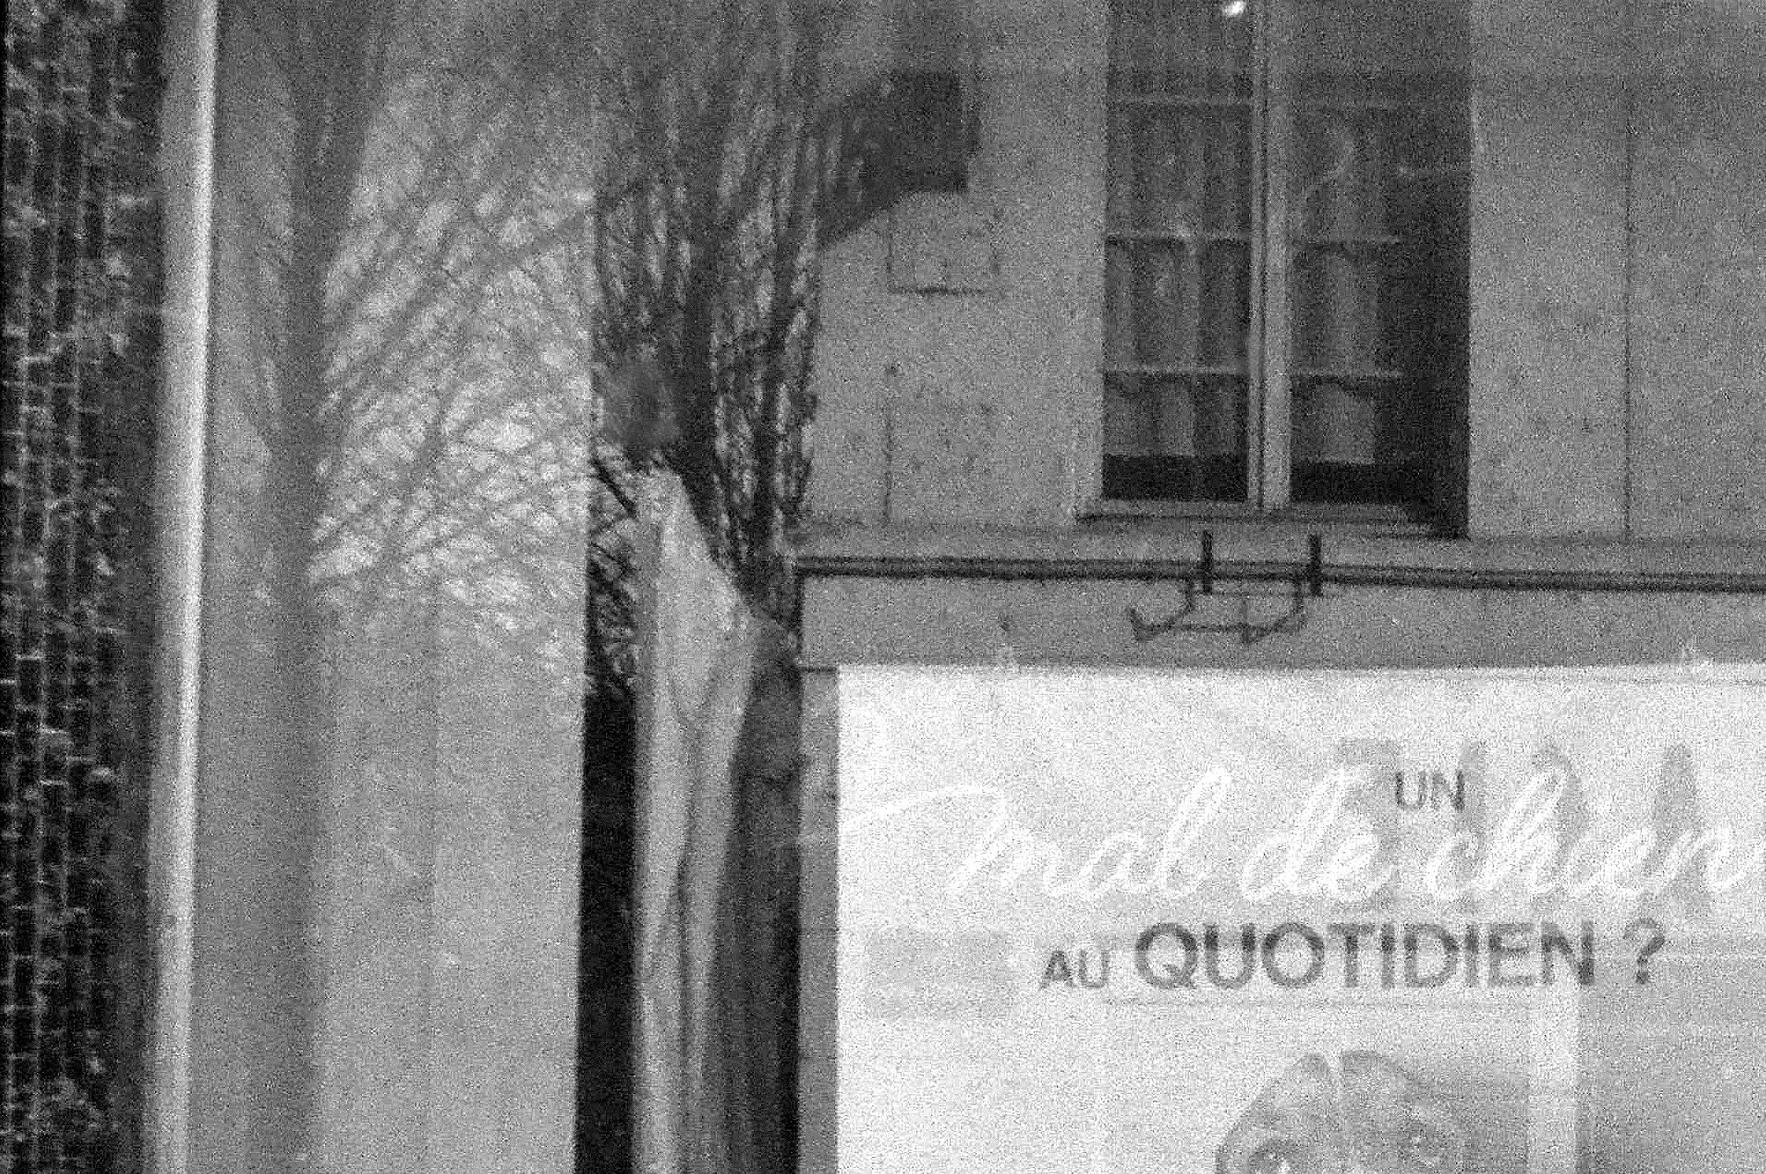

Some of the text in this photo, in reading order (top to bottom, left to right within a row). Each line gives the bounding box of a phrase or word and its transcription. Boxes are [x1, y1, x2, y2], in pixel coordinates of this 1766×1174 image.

[1395, 767, 1464, 813] UN
[843, 764, 1214, 901] mal
[1238, 768, 1396, 902] de
[1038, 915, 1668, 991] AU QUOTIDIEN ?
